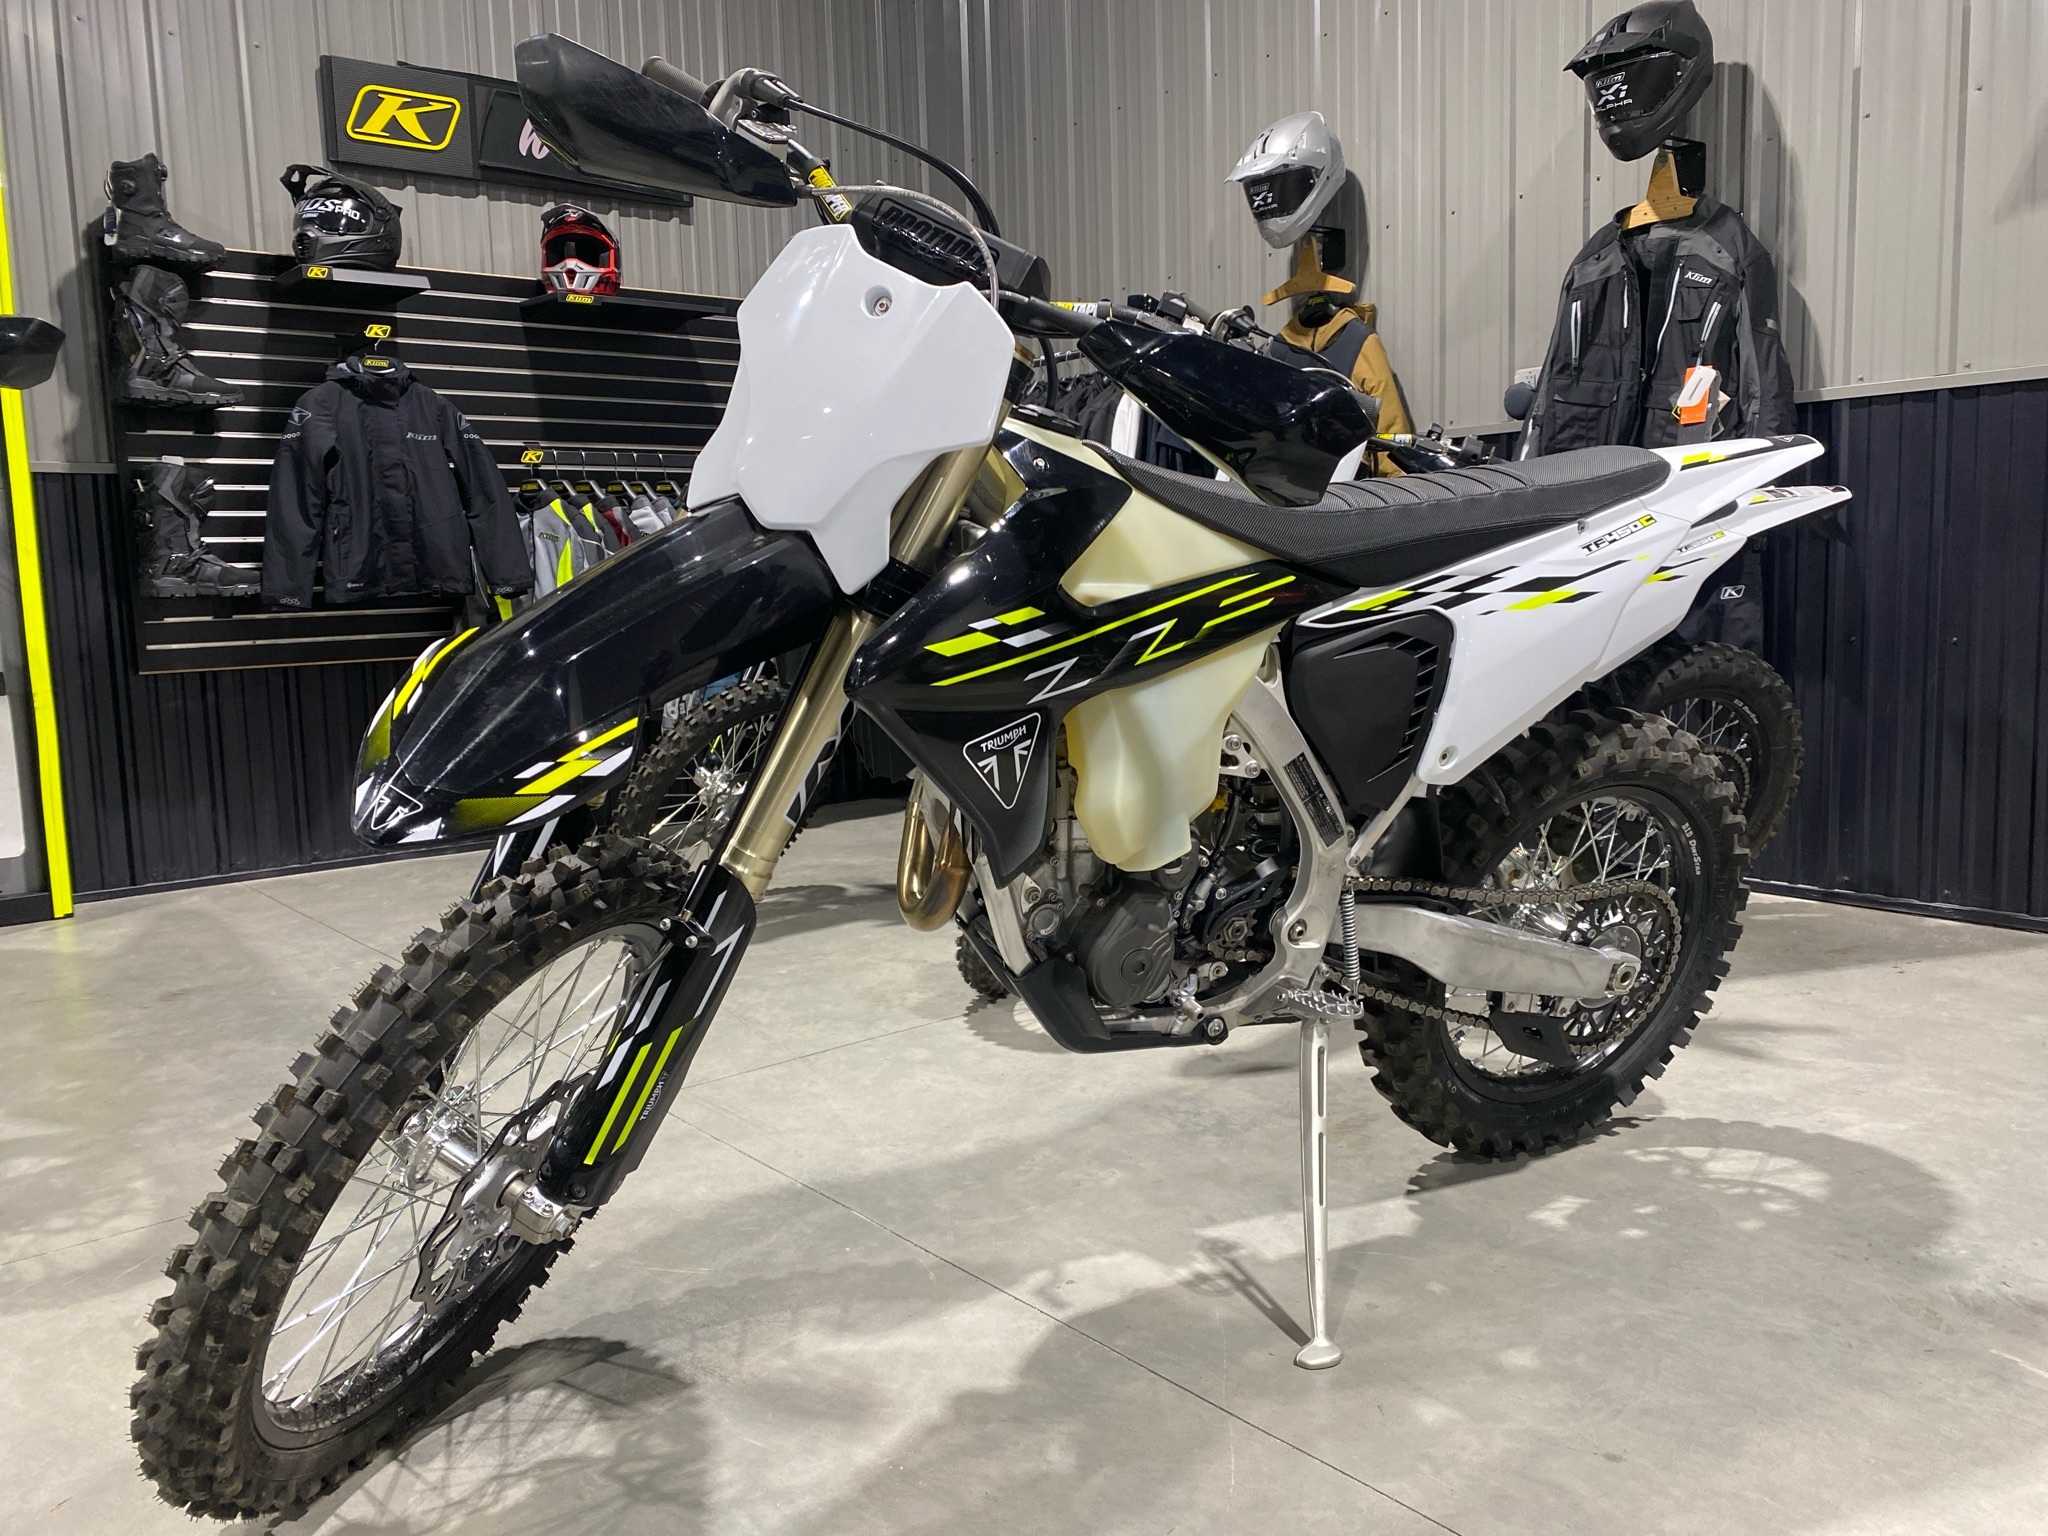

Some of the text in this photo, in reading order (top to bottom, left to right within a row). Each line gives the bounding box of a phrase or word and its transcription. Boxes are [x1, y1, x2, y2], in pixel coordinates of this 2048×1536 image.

[353, 93, 452, 143] K
[980, 724, 1027, 753] TRIUMPH
[640, 1081, 665, 1121] TRIUMPH
